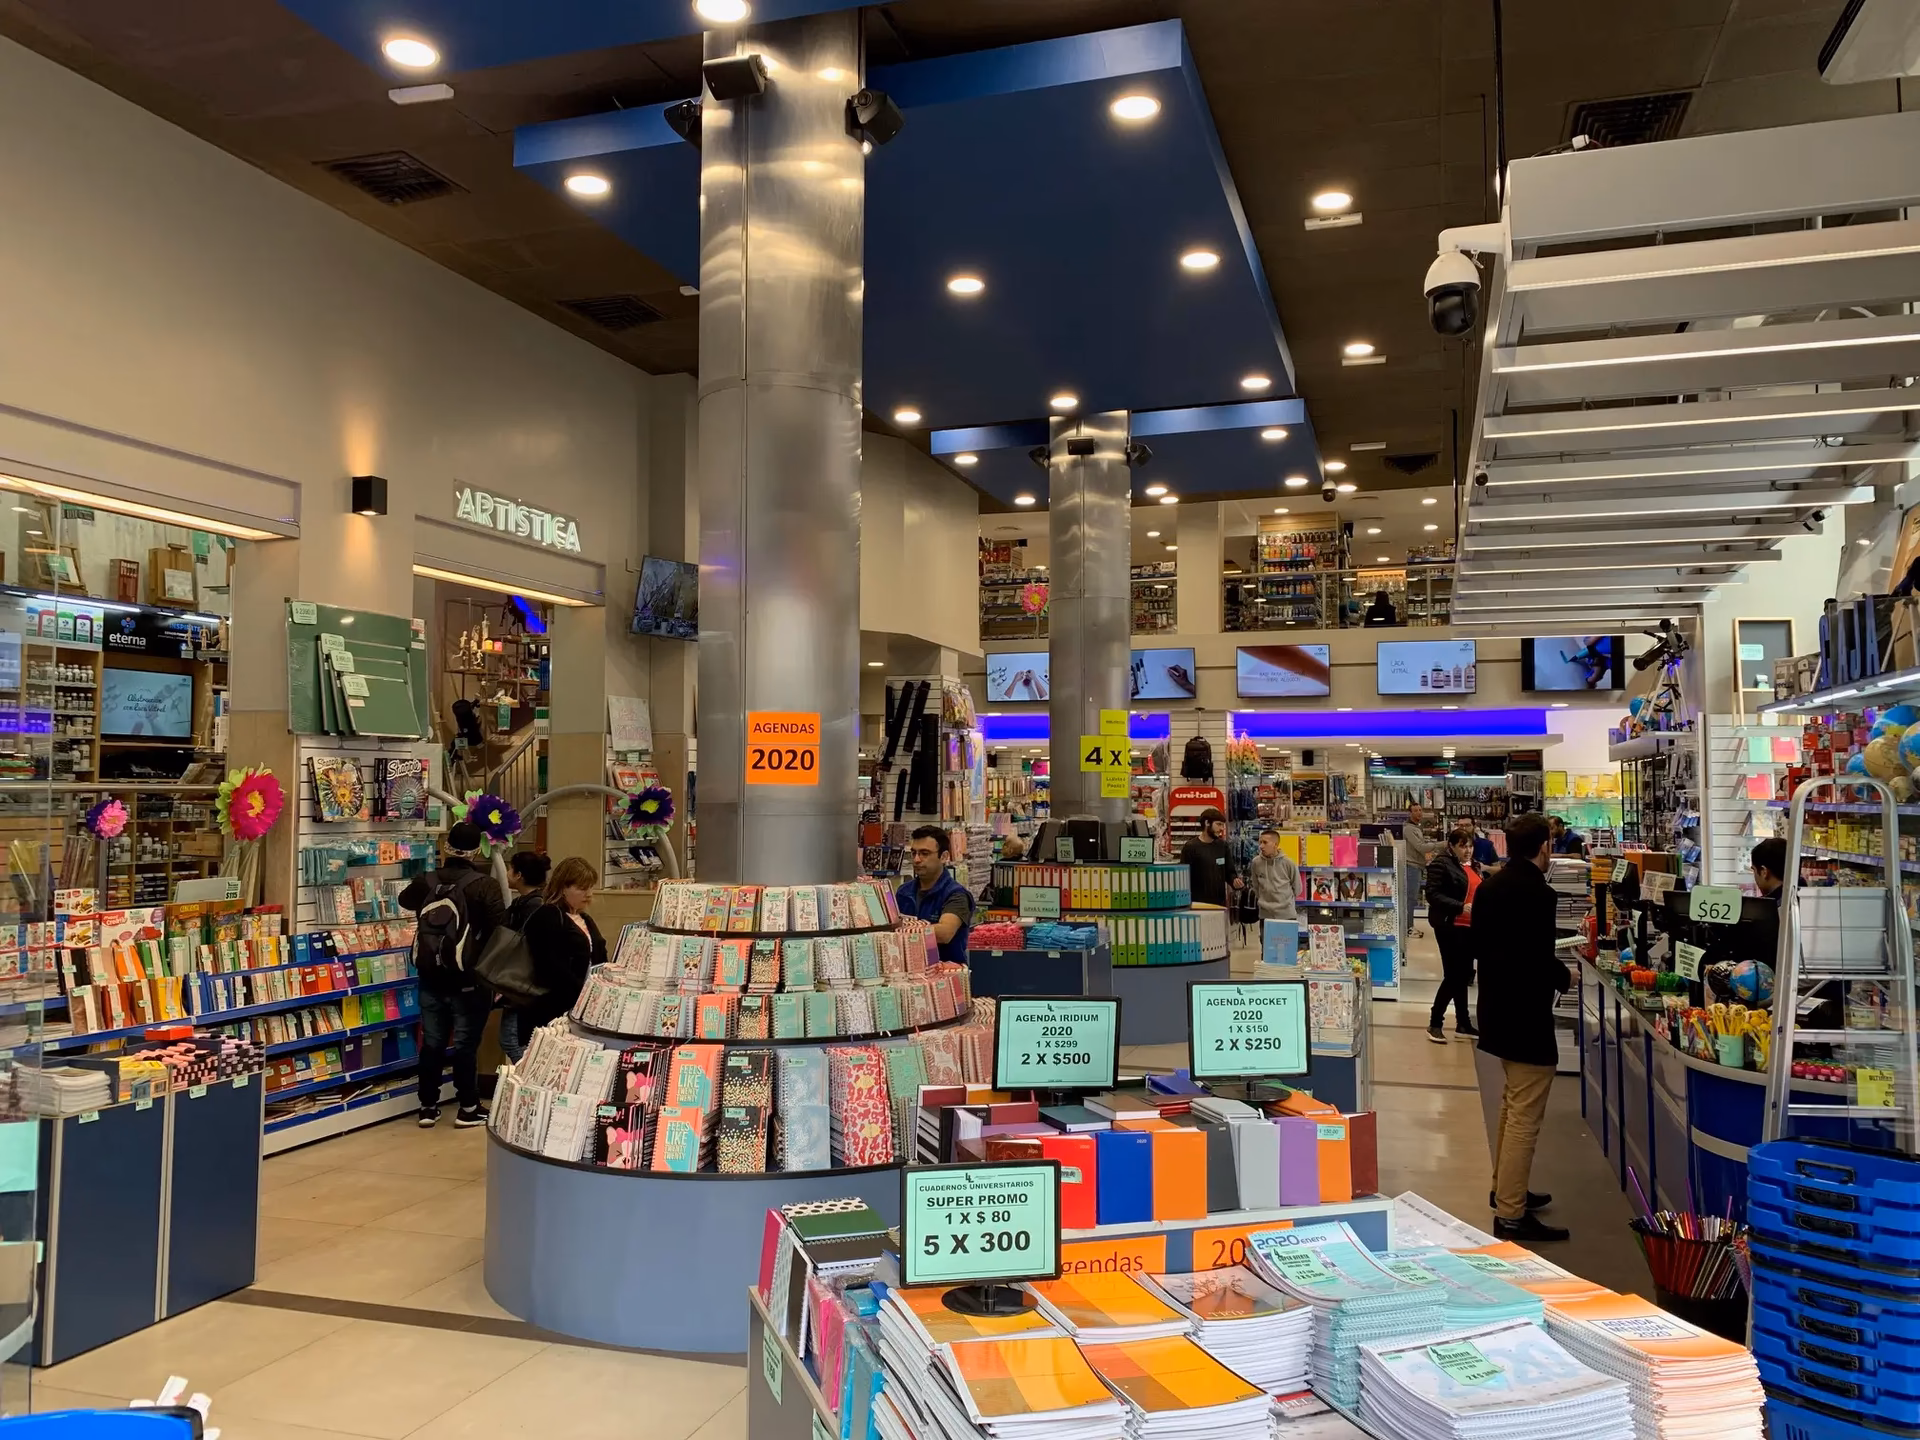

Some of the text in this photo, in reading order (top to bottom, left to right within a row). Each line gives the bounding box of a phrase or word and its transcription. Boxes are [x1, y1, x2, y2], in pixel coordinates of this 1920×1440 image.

[109, 633, 147, 646] eterna
[753, 722, 815, 734] AGENDAS
[752, 748, 814, 771] 2020
[1085, 746, 1103, 765] 4
[1697, 900, 1731, 920] $62
[1206, 997, 1287, 1006] AGENDA POCKET
[1015, 1014, 1099, 1022] AGENDA IRIDIUM
[1232, 1010, 1263, 1021] 2020
[1041, 1026, 1073, 1036] 2020
[1228, 1024, 1269, 1033] 1 X $150
[1044, 1040, 1052, 1048] X
[1054, 1040, 1078, 1049] $299
[1214, 1037, 1281, 1051] 2 X $250
[1021, 1052, 1091, 1066] 2 X $500
[919, 1181, 1034, 1192] CUADERNOS UNIVERSITARIOS
[927, 1193, 1028, 1207] SUPER PROMO
[945, 1210, 1011, 1225] 1 X $ 80
[924, 1230, 1031, 1255] 5 X 300
[1253, 1234, 1327, 1250] 2020 enero
[1211, 1238, 1247, 1268] 20
[1061, 1251, 1143, 1274] gendas
